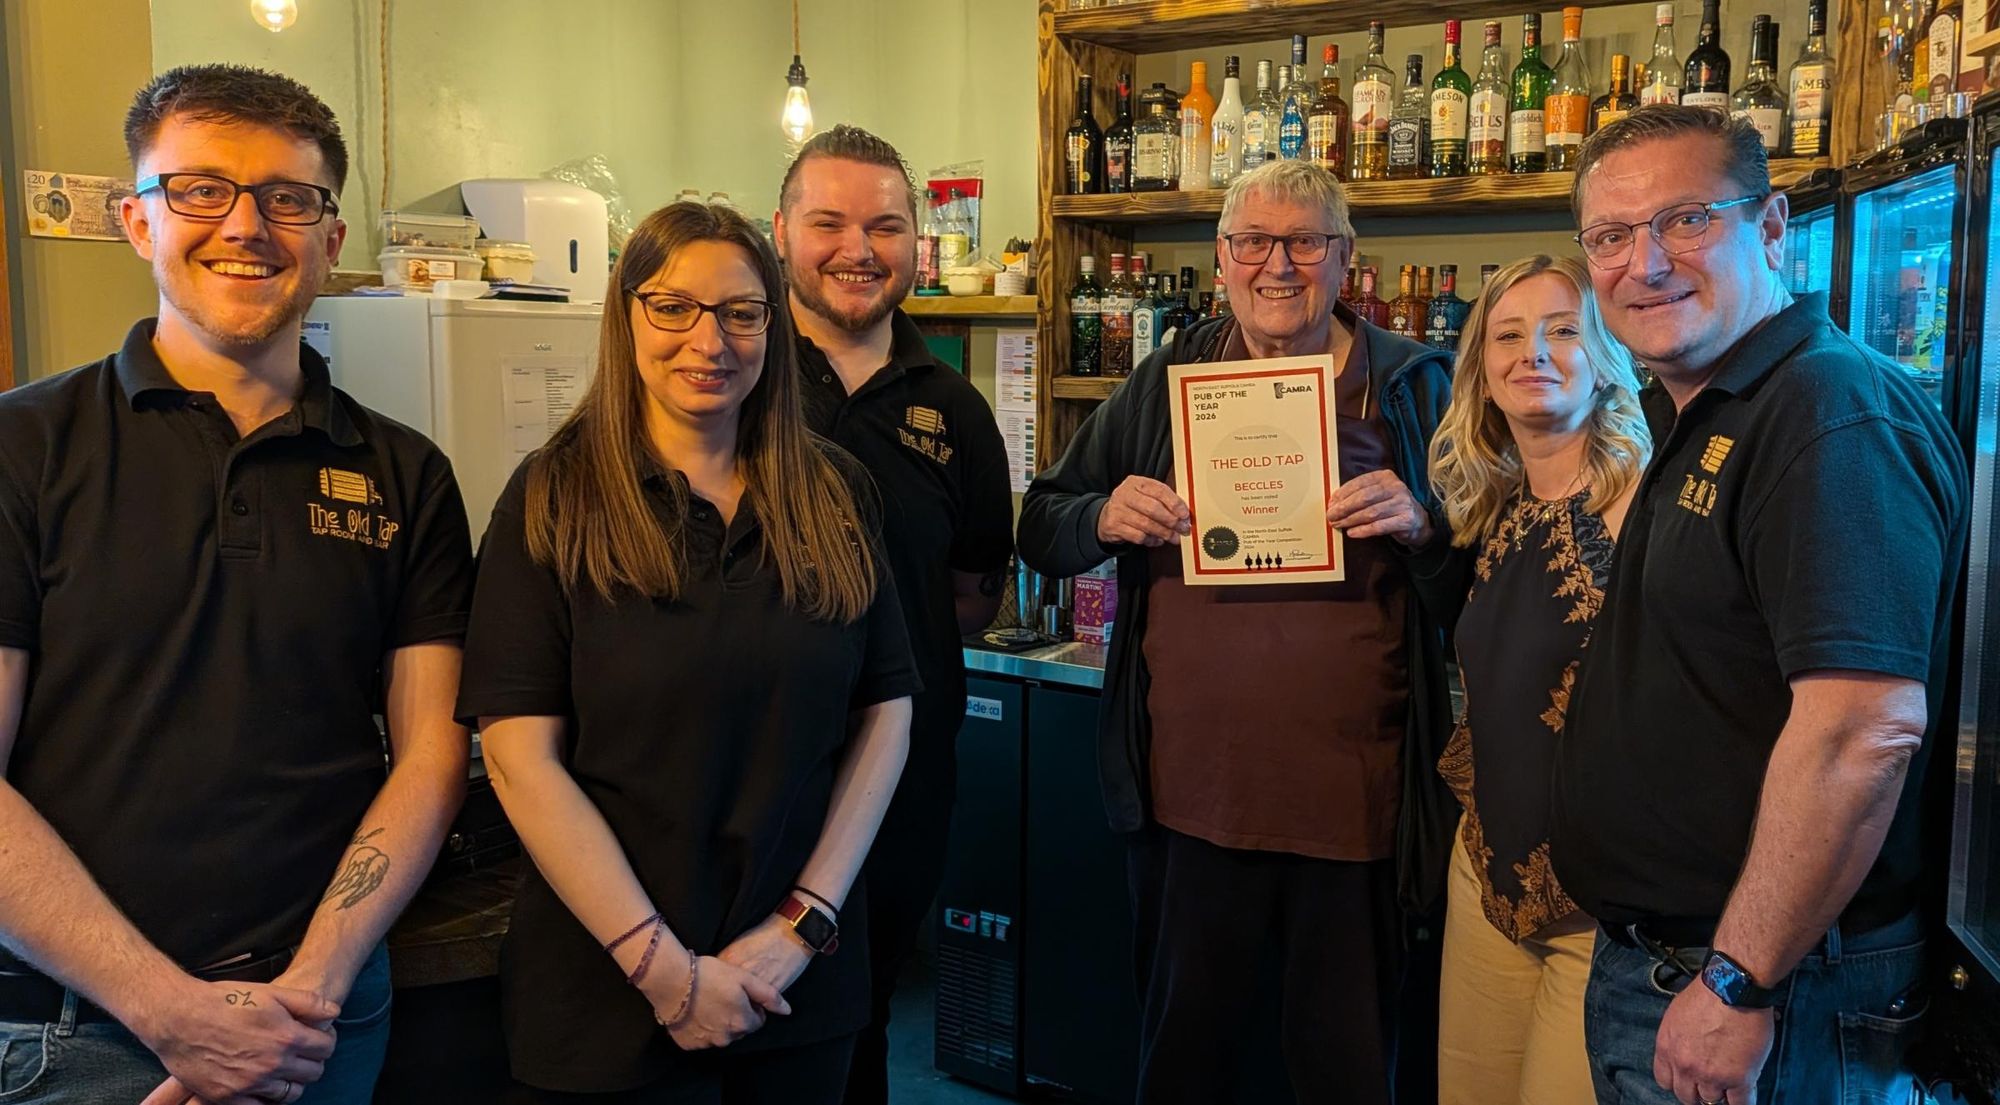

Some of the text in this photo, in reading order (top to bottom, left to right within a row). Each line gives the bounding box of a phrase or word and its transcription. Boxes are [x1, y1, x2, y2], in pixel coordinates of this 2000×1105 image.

[1280, 385, 1312, 394] CAMRA
[1215, 391, 1227, 399] OF
[1229, 390, 1247, 398] THE
[1194, 402, 1219, 410] YEAR
[1195, 412, 1216, 421] 2026
[1210, 454, 1304, 470] THE OLD TAP
[1234, 480, 1284, 492] BECCLES
[1242, 505, 1279, 515] Winner
[306, 503, 340, 528] The
[347, 509, 370, 536] Old
[311, 526, 328, 535] TAP
[1076, 583, 1102, 591] MARTINI
